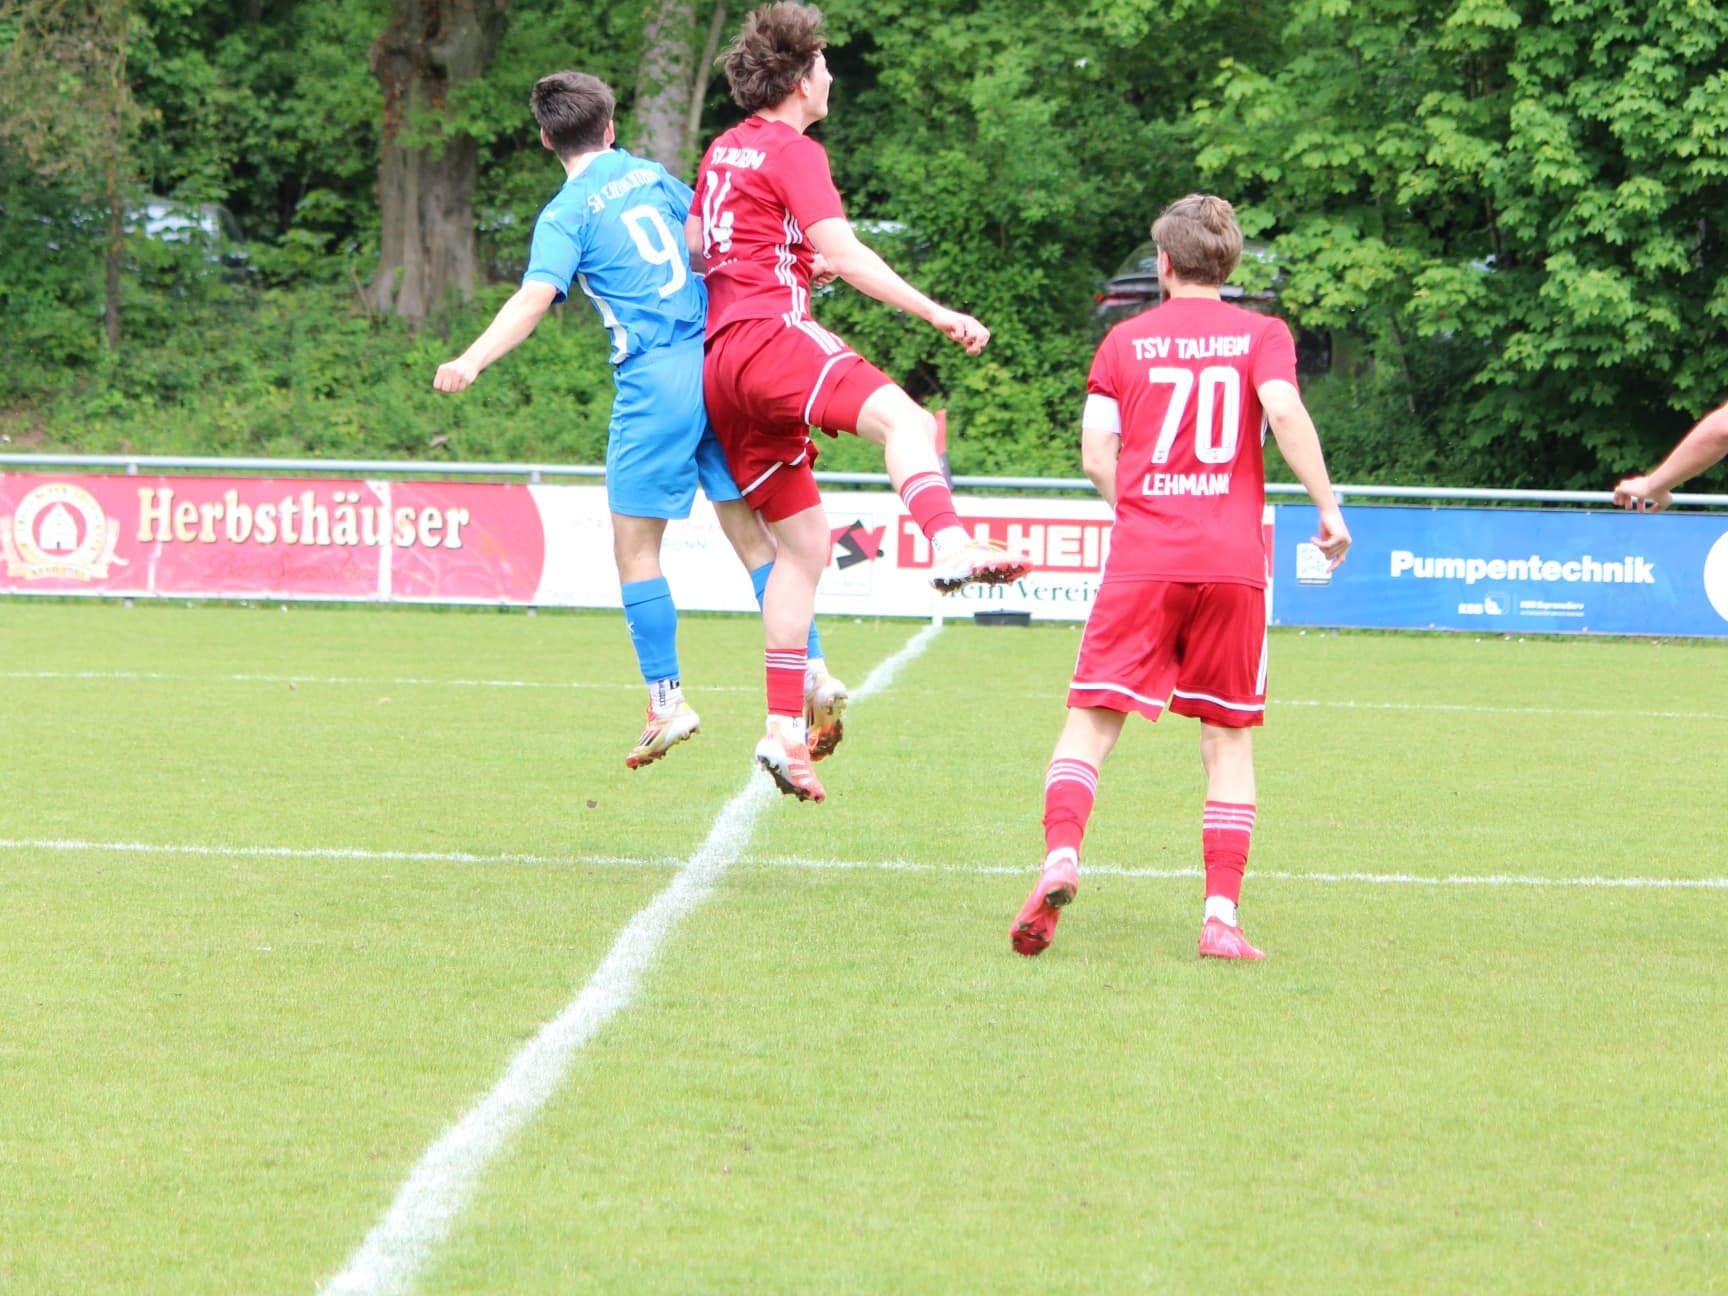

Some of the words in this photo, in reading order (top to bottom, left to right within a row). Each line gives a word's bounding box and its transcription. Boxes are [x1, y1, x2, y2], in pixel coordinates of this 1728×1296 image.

[620, 205, 686, 299] 9
[1132, 337, 1171, 360] TSV
[1149, 365, 1240, 464] 70
[137, 488, 470, 548] Herbsthäuser
[903, 521, 1112, 568] THEI
[1390, 550, 1656, 585] Pumpentechnik
